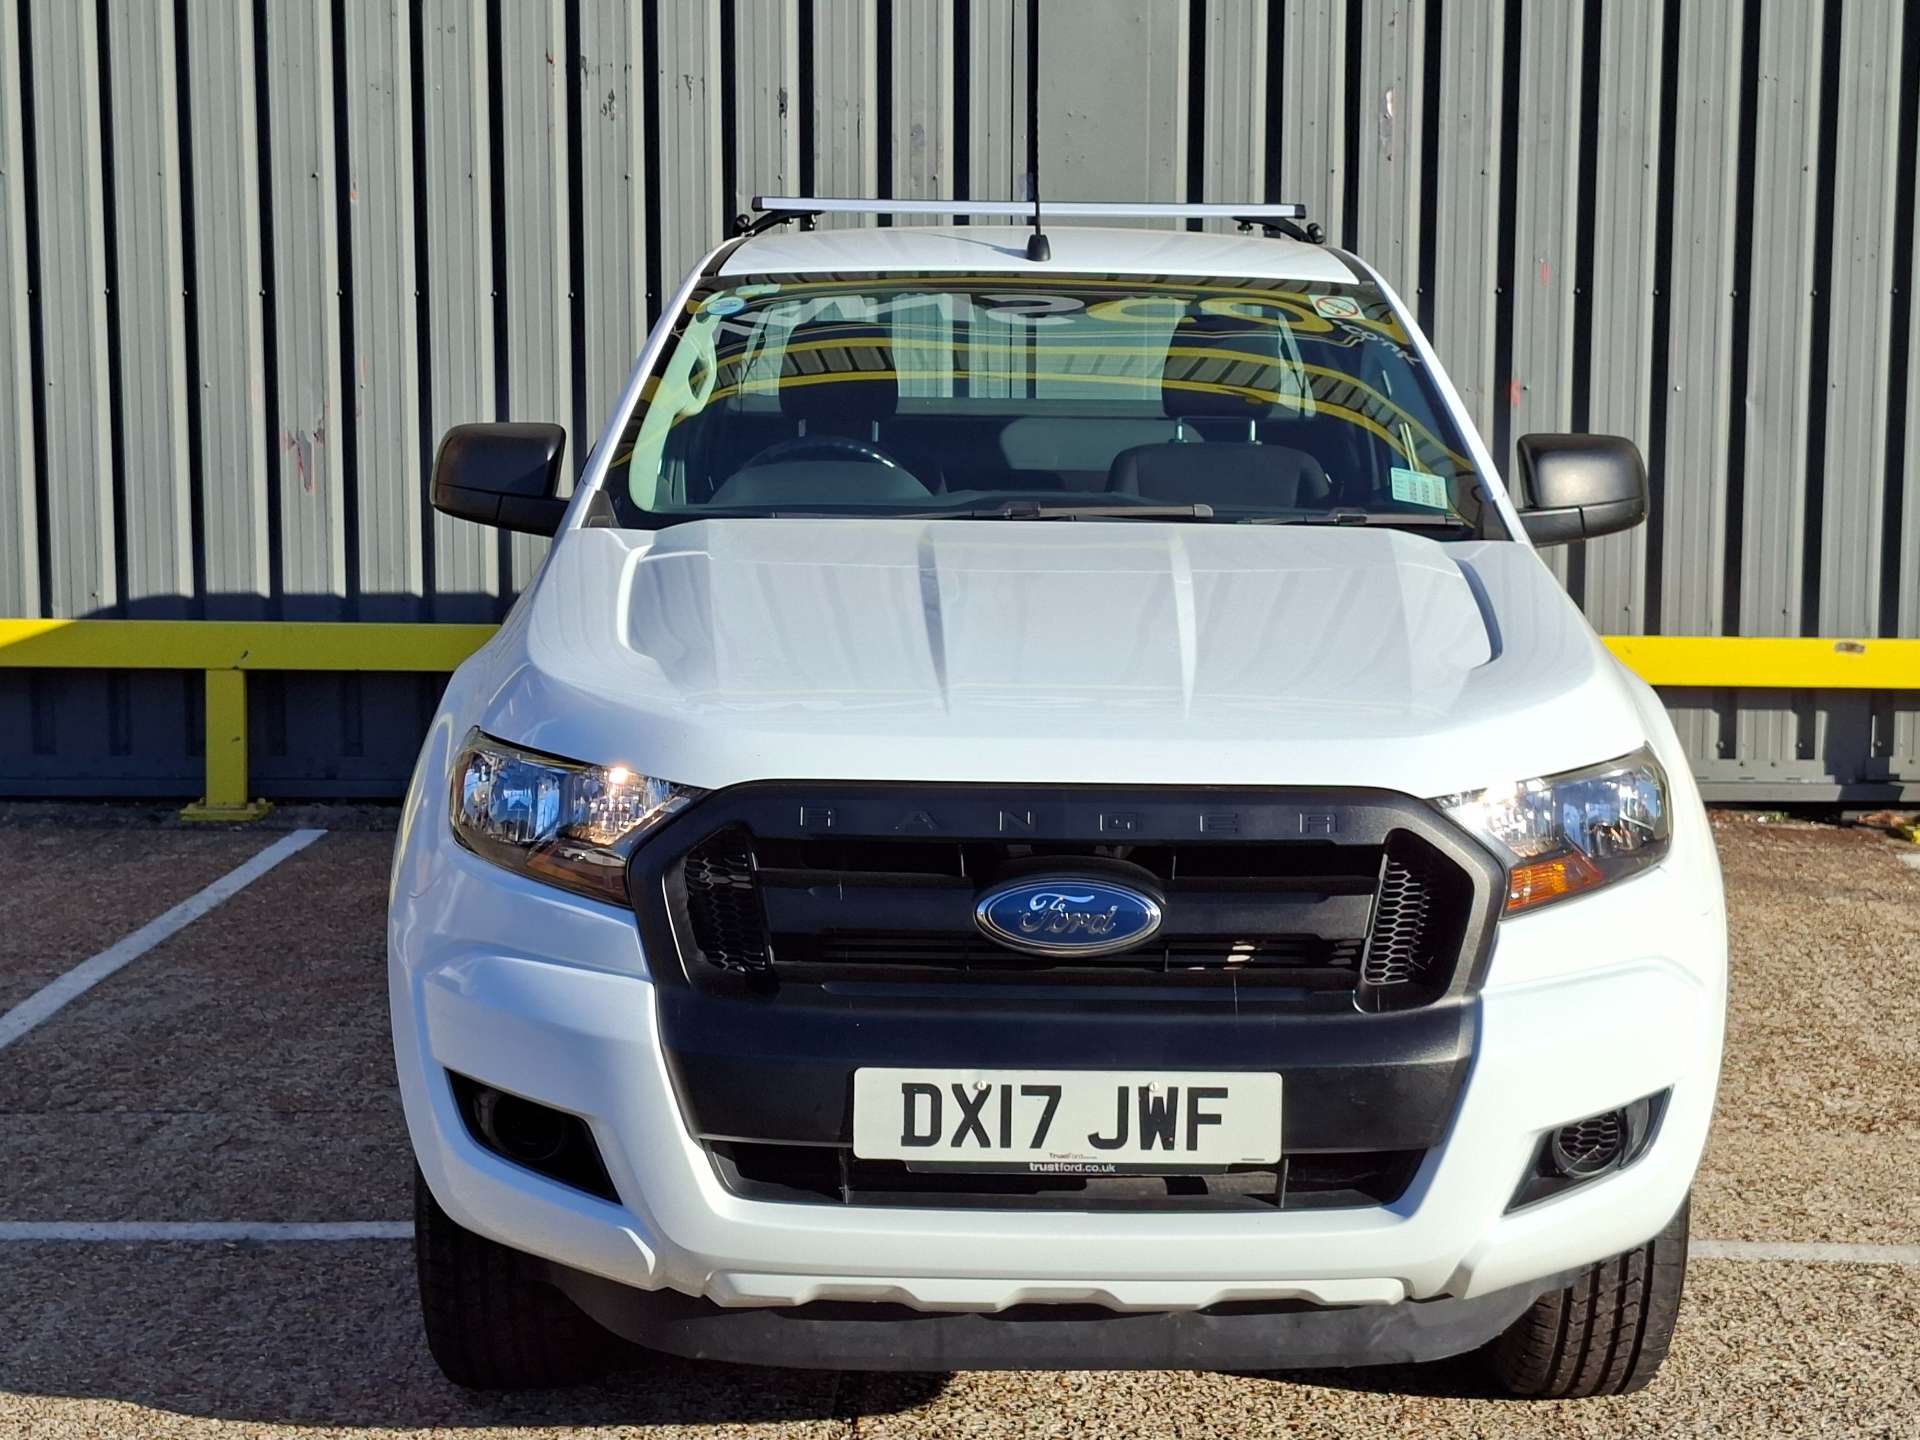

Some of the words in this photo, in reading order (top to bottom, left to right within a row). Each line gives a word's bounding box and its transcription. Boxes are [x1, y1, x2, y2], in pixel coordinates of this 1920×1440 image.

[799, 805, 1339, 834] RANGER
[1018, 892, 1118, 934] Ford
[901, 1083, 1062, 1149] DX17
[1088, 1086, 1228, 1151] JWF
[1029, 1162, 1116, 1173] trustford.co.uk
